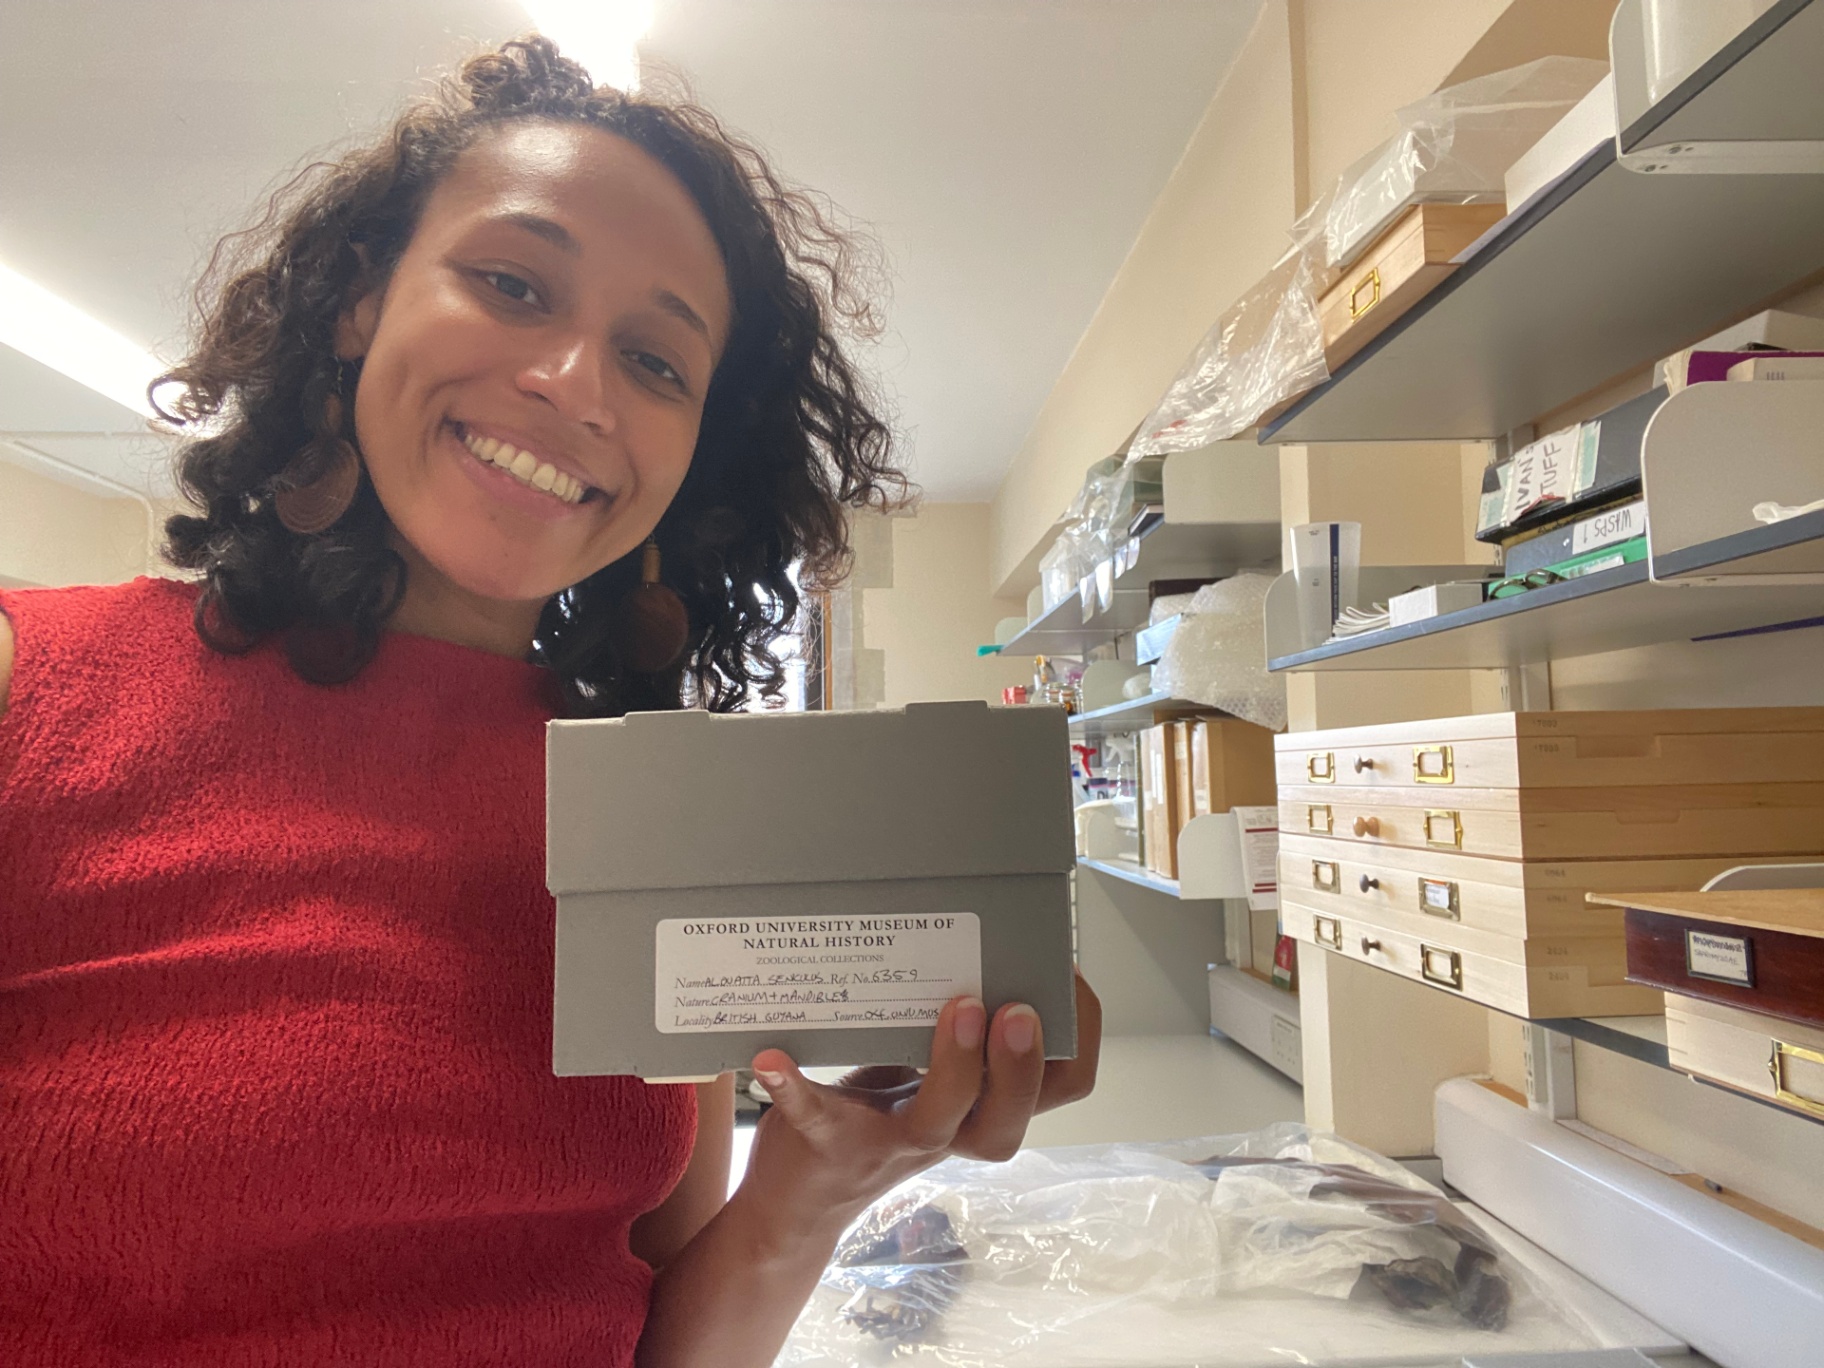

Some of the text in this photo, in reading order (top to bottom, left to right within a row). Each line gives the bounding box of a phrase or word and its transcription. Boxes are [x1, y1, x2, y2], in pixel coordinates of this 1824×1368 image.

[1514, 445, 1535, 511] IVAN'S
[1540, 442, 1562, 498] TUFF
[1594, 508, 1632, 537] WASPS
[683, 918, 955, 936] OXFORD UNIVERSITY MUSEUM OF
[743, 935, 896, 949] NATURAL HISTORY
[756, 954, 885, 965] ZOOLOGICAL COLLECTIONS
[830, 973, 849, 988] Ref.
[872, 968, 918, 984] 6359
[674, 1015, 713, 1029] Locality
[713, 1011, 757, 1025] BRITISH
[764, 1011, 807, 1022] GUYANA
